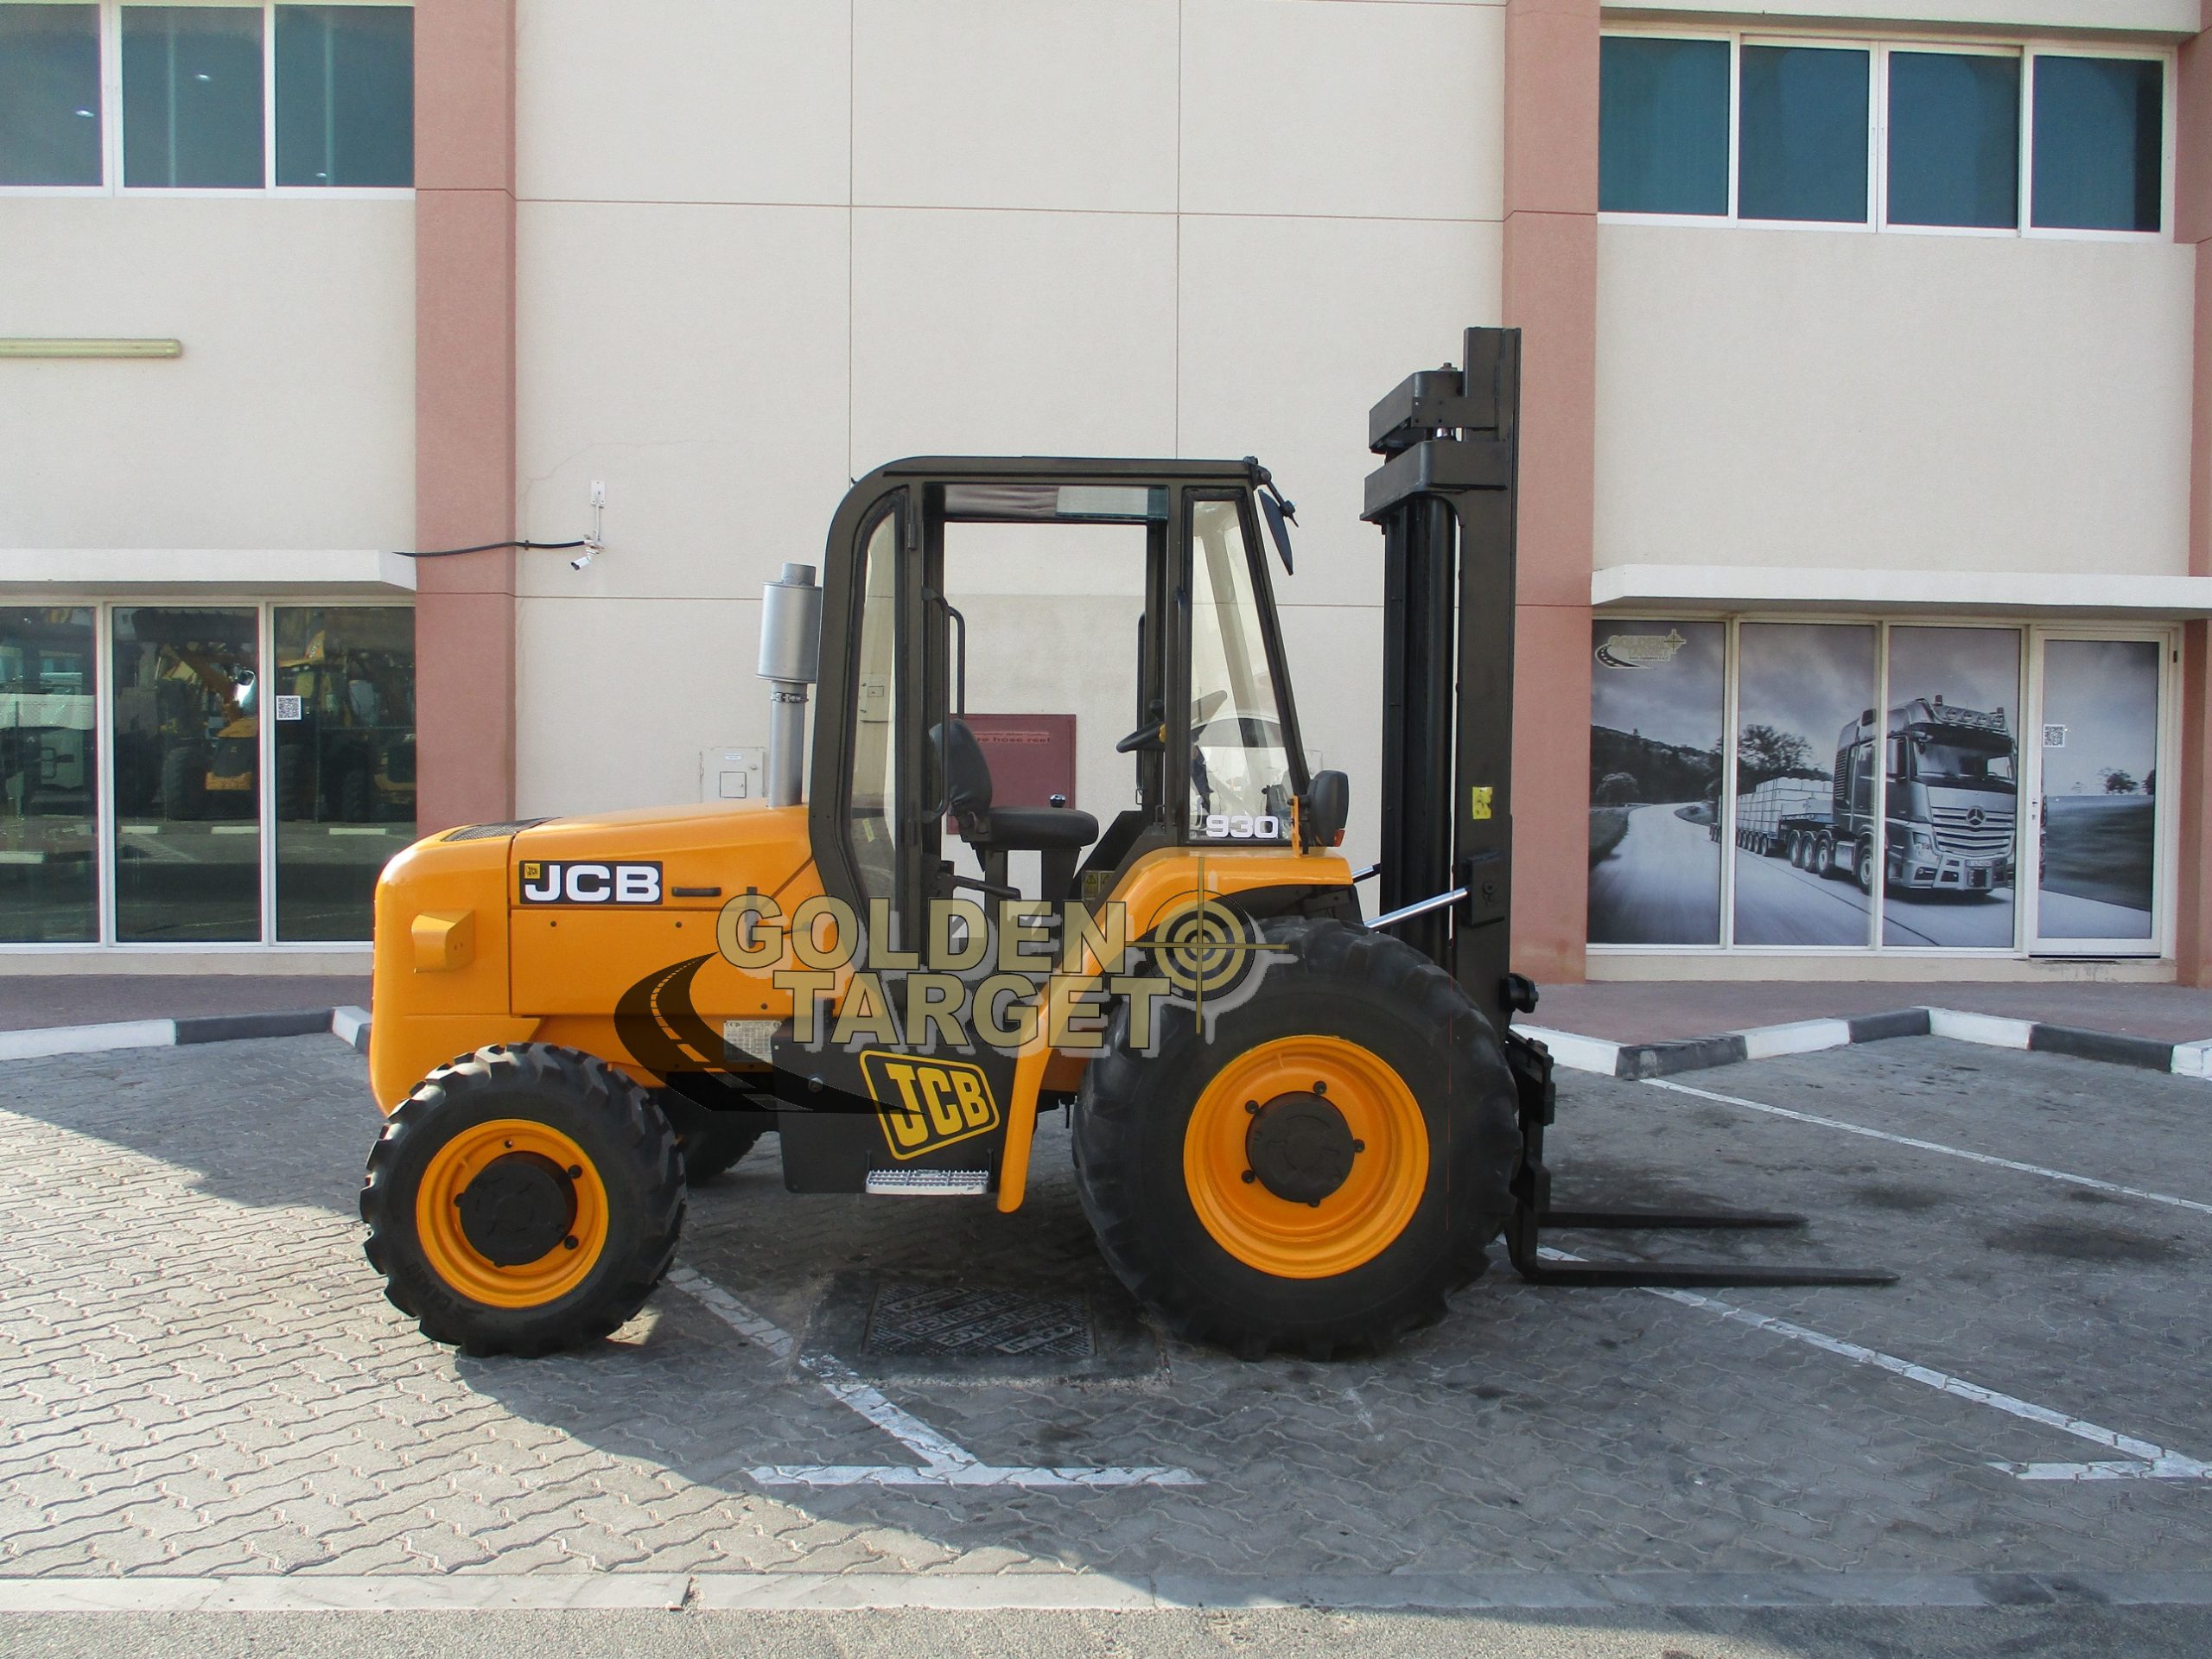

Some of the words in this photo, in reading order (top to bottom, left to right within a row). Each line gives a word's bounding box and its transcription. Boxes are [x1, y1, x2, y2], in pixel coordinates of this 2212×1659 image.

[1205, 815, 1279, 838] 930
[524, 864, 660, 902] JCB
[884, 1062, 991, 1147] JCB
